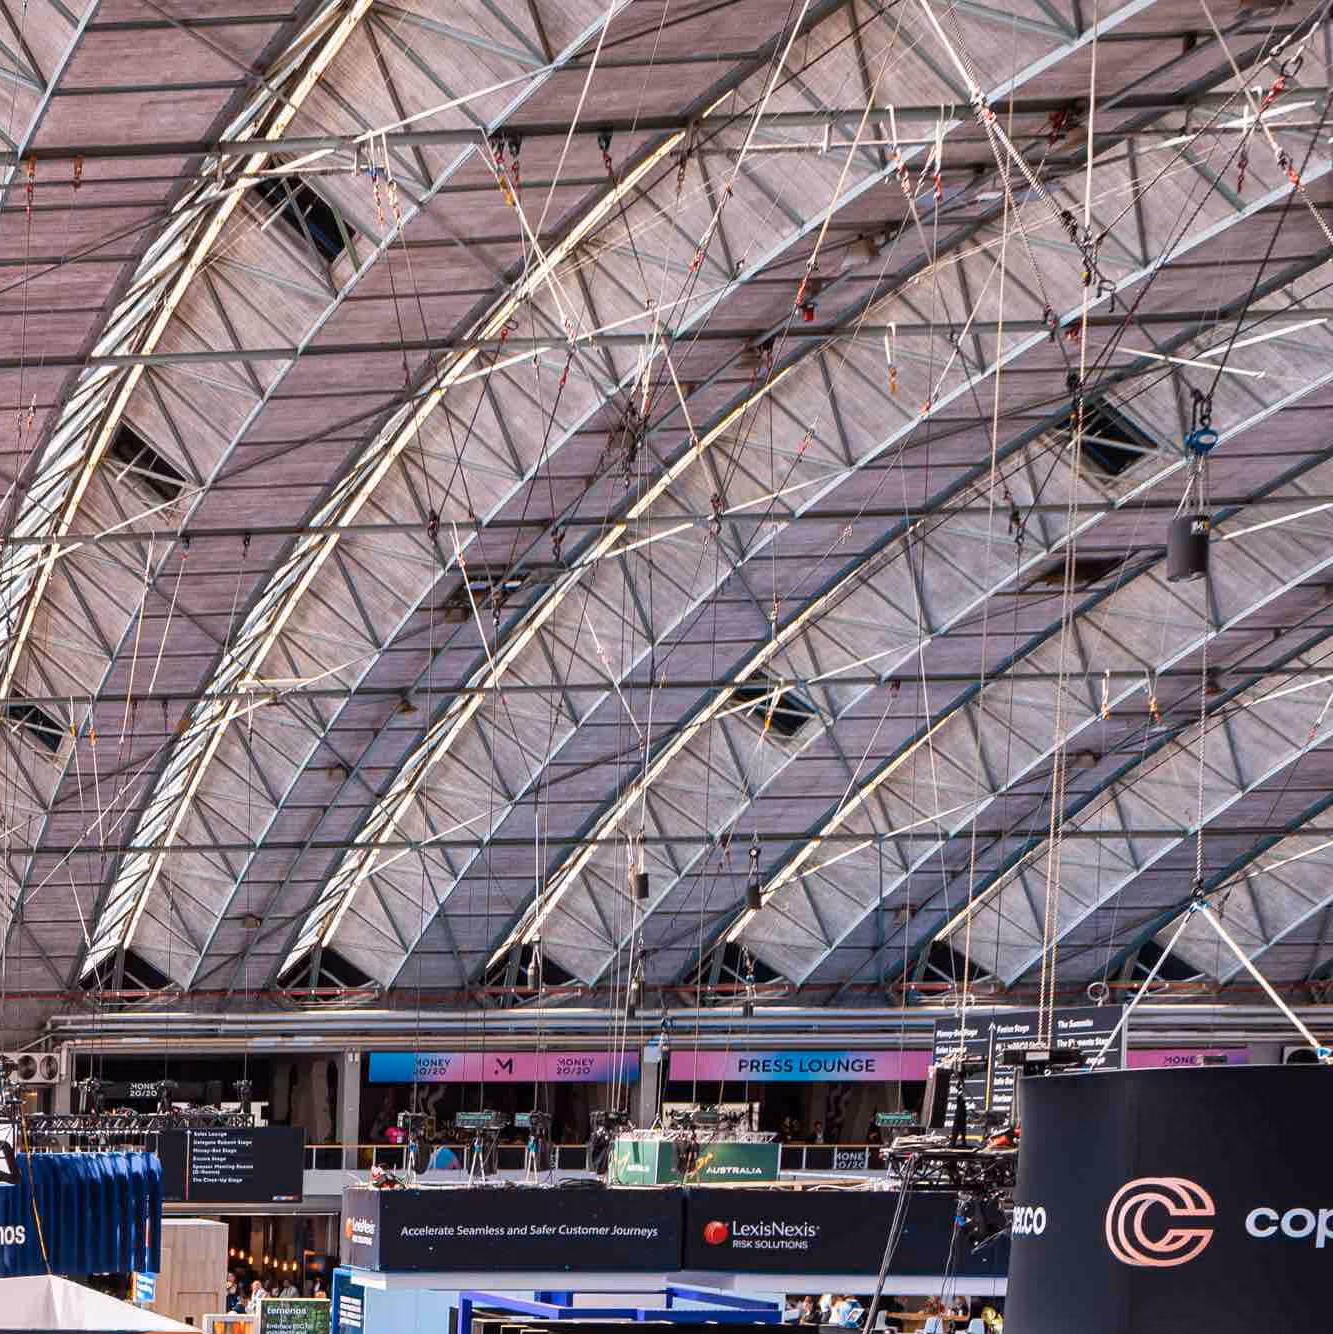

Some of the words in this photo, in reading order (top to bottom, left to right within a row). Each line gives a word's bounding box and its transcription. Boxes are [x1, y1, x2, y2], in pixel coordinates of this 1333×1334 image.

[556, 1058, 594, 1067] MONEY
[1164, 1056, 1197, 1064] MONE
[738, 1059, 793, 1072] PRESS
[799, 1058, 876, 1073] LOUNGE
[556, 1066, 591, 1075] 20/20
[706, 1166, 762, 1175] AUSTRALIA
[400, 1225, 455, 1237] Accelerate
[456, 1225, 505, 1236] Seamless
[507, 1225, 528, 1235] and
[530, 1225, 556, 1235] Safer
[558, 1225, 608, 1236] Customer
[610, 1225, 658, 1237] Journeys
[733, 1240, 753, 1249] RISK
[755, 1240, 808, 1249] SOLUTIONS
